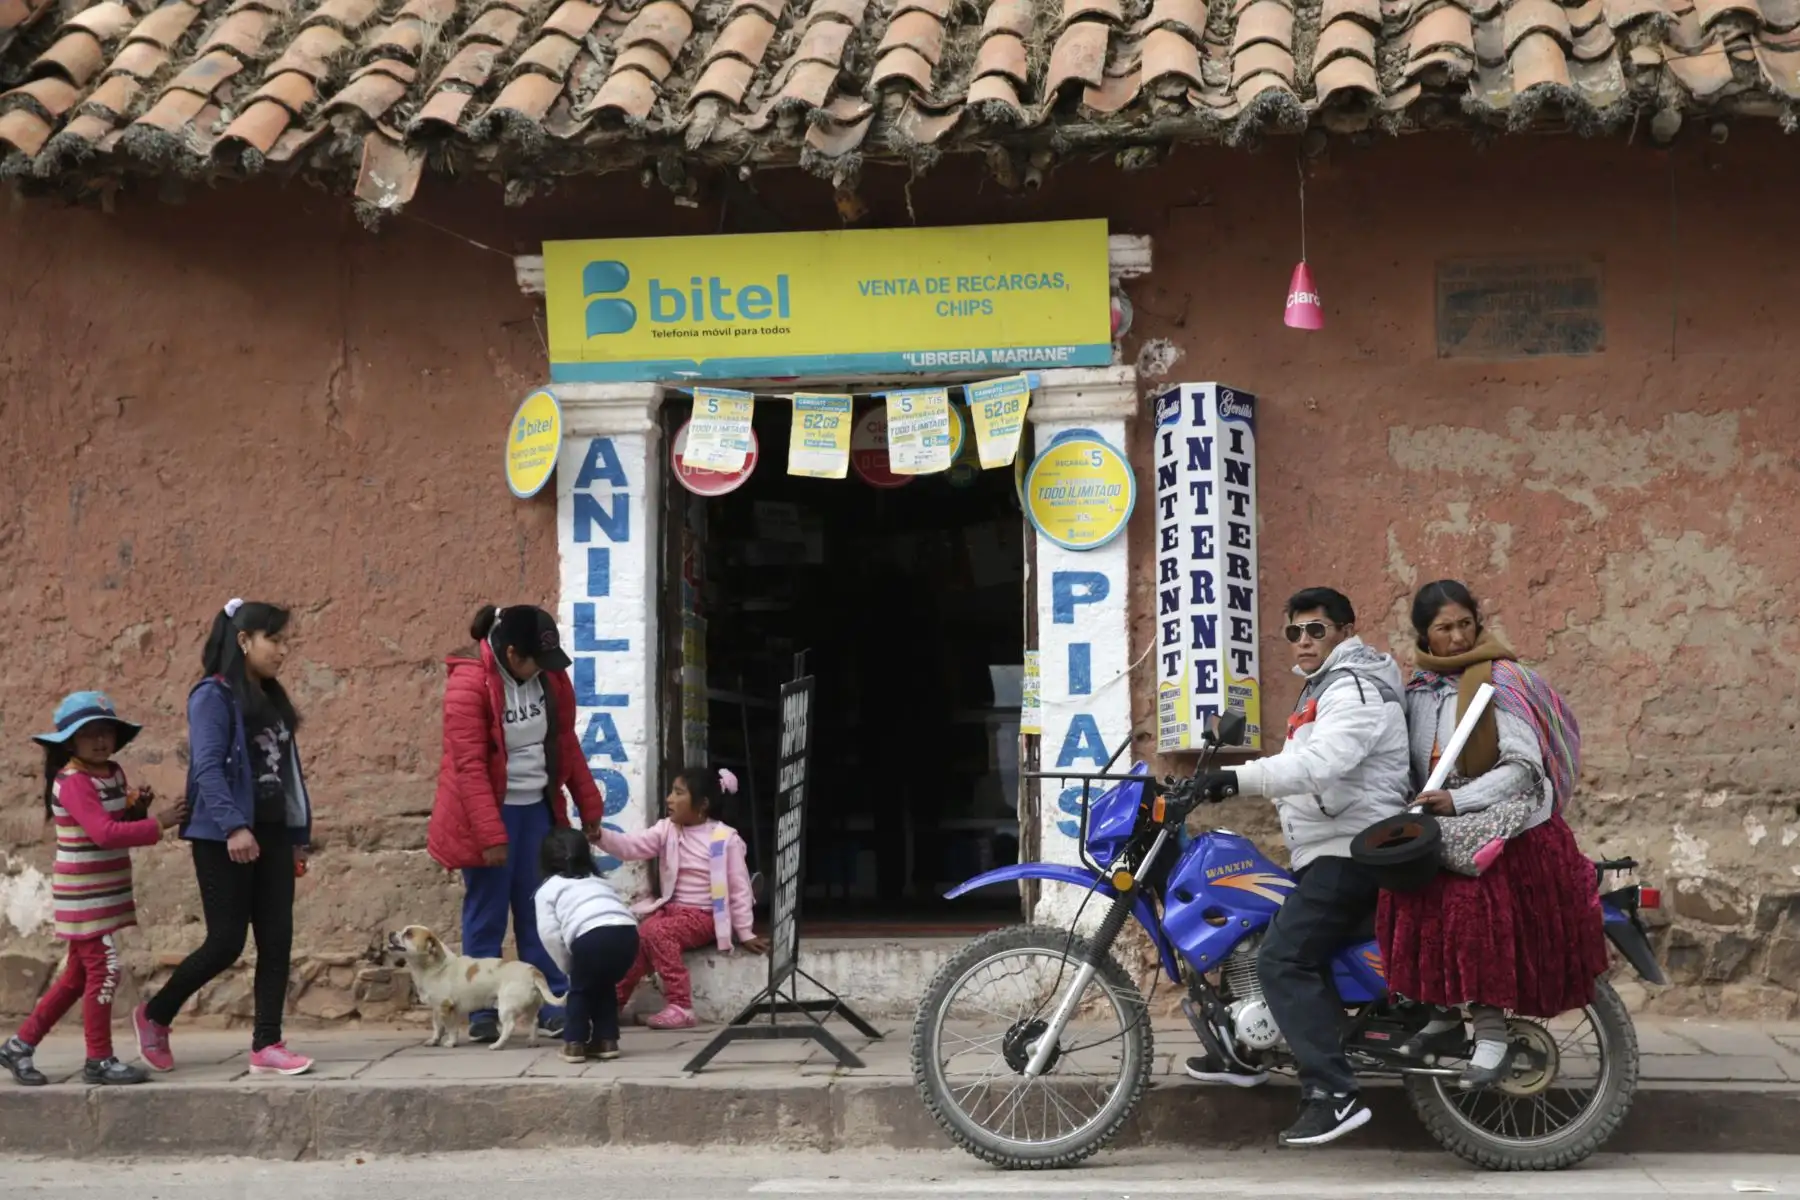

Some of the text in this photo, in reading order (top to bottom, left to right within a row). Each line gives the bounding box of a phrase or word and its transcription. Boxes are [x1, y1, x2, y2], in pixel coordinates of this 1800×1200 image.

[858, 272, 1070, 296] VENTA DE RECARGAS,
[648, 274, 790, 323] bitel
[936, 299, 993, 317] CHIPS
[702, 326, 731, 337] móvil
[734, 329, 758, 338] para
[761, 325, 791, 335] todos
[708, 398, 719, 413] 5
[901, 397, 912, 413] 5
[526, 415, 553, 437] bitel
[1091, 450, 1103, 467] 5
[1039, 483, 1121, 500] TODO ILIMITADO
[1158, 431, 1181, 677] INTERNET
[1223, 427, 1253, 674] INTERNET
[1186, 392, 1219, 738] INTERNET
[1205, 859, 1253, 878] WANXIN
